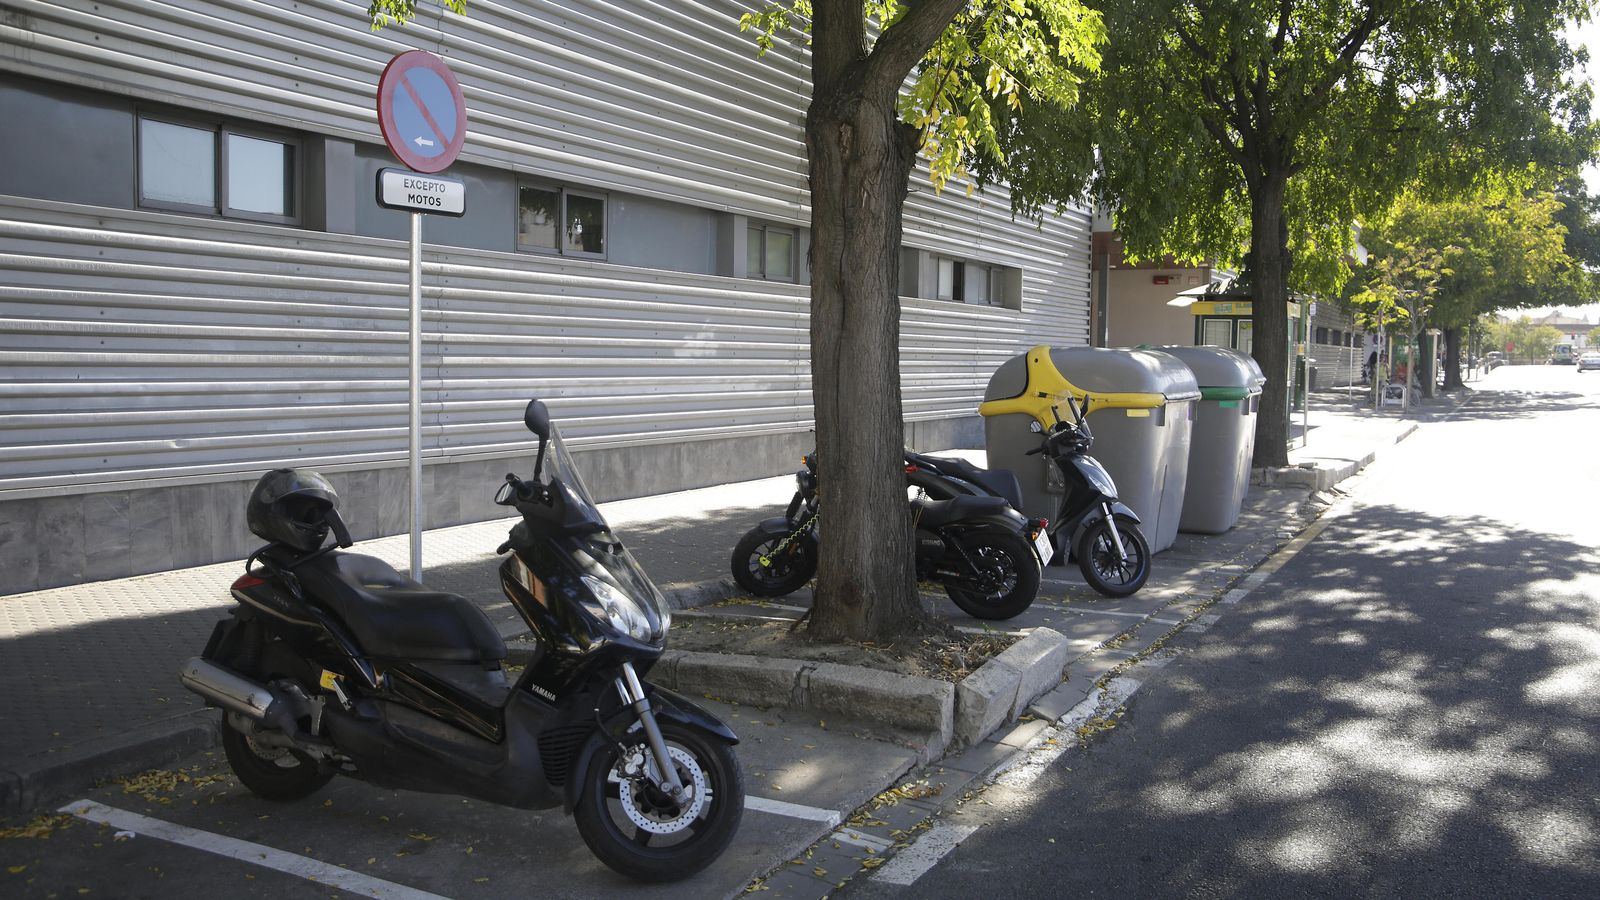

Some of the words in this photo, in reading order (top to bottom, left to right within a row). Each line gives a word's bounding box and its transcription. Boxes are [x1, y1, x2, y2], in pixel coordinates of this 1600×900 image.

[404, 179, 445, 193] EXCEPTO
[408, 194, 441, 206] MOTOS
[532, 684, 556, 701] YAMAHA
